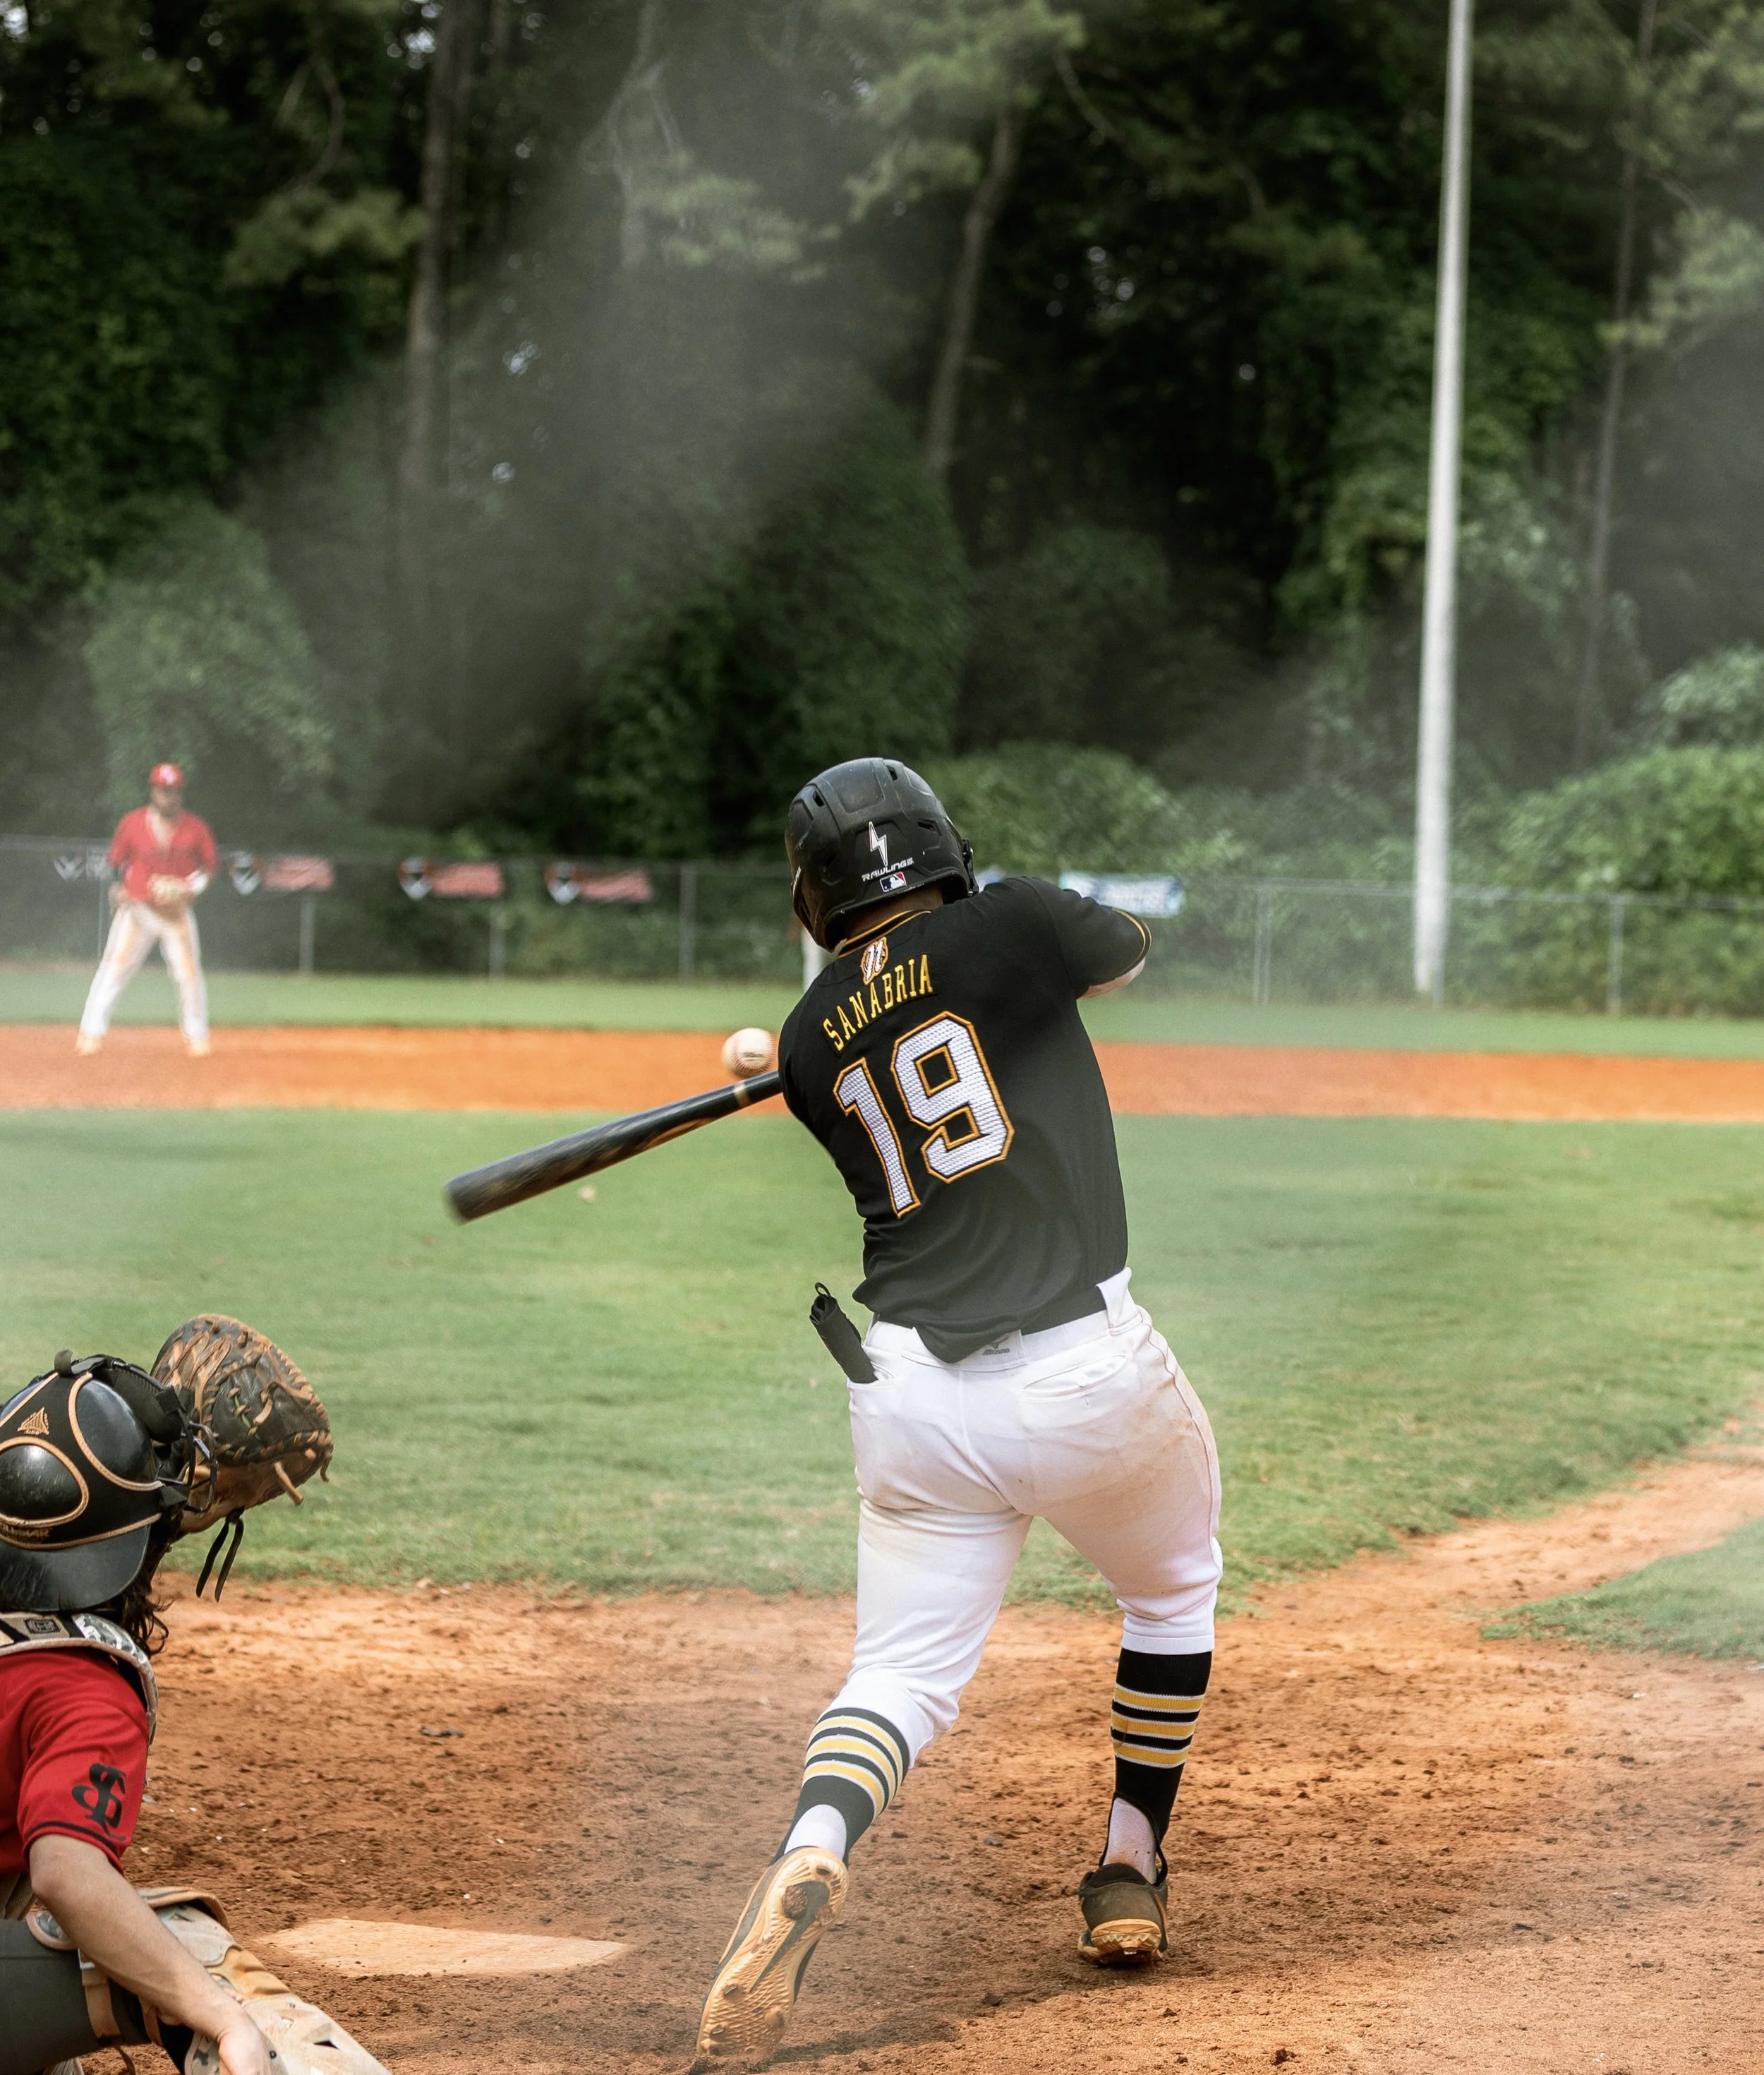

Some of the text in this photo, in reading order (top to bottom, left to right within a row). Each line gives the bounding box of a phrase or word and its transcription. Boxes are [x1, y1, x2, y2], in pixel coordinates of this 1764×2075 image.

[861, 857, 914, 882] RAWLINGS
[823, 954, 934, 1052] SANABRIA
[833, 1010, 1015, 1219] 19
